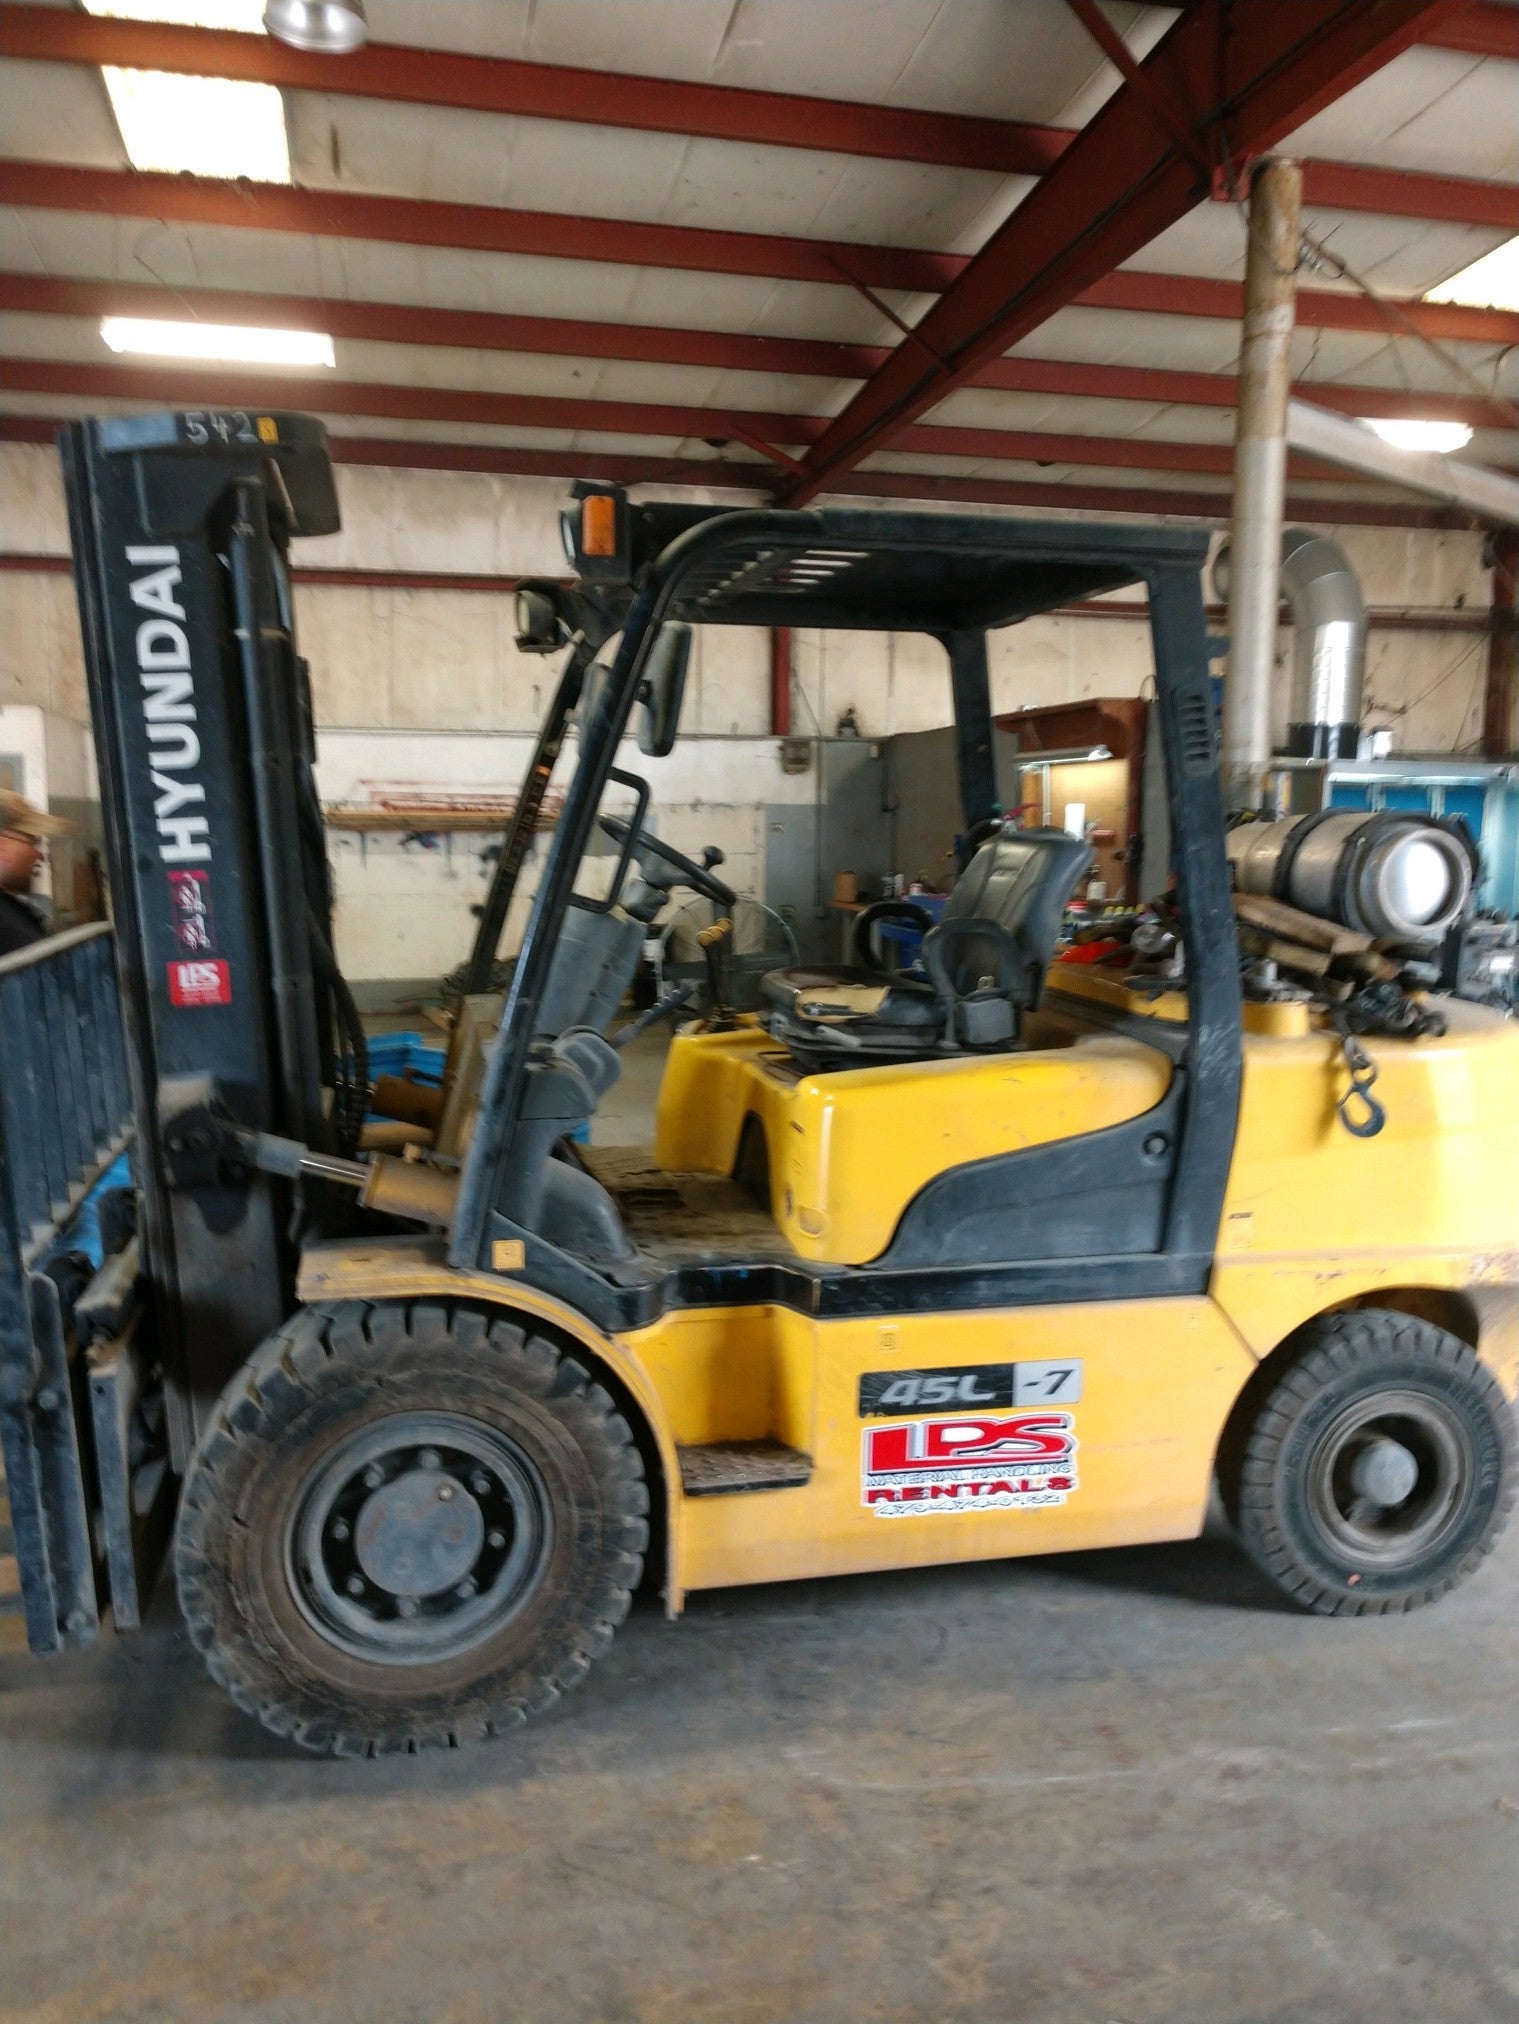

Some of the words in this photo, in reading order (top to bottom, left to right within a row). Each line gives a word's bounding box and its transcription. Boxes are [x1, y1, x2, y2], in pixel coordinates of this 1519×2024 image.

[185, 411, 259, 445] 542
[125, 546, 212, 863] HYUNDAI
[878, 1375, 997, 1406] 45L
[1025, 1369, 1075, 1395] -7
[863, 1414, 1073, 1474] LPS
[864, 1469, 967, 1487] MATERIAL
[971, 1463, 1073, 1482] HANDLING
[866, 1475, 1073, 1504] RENTALS
